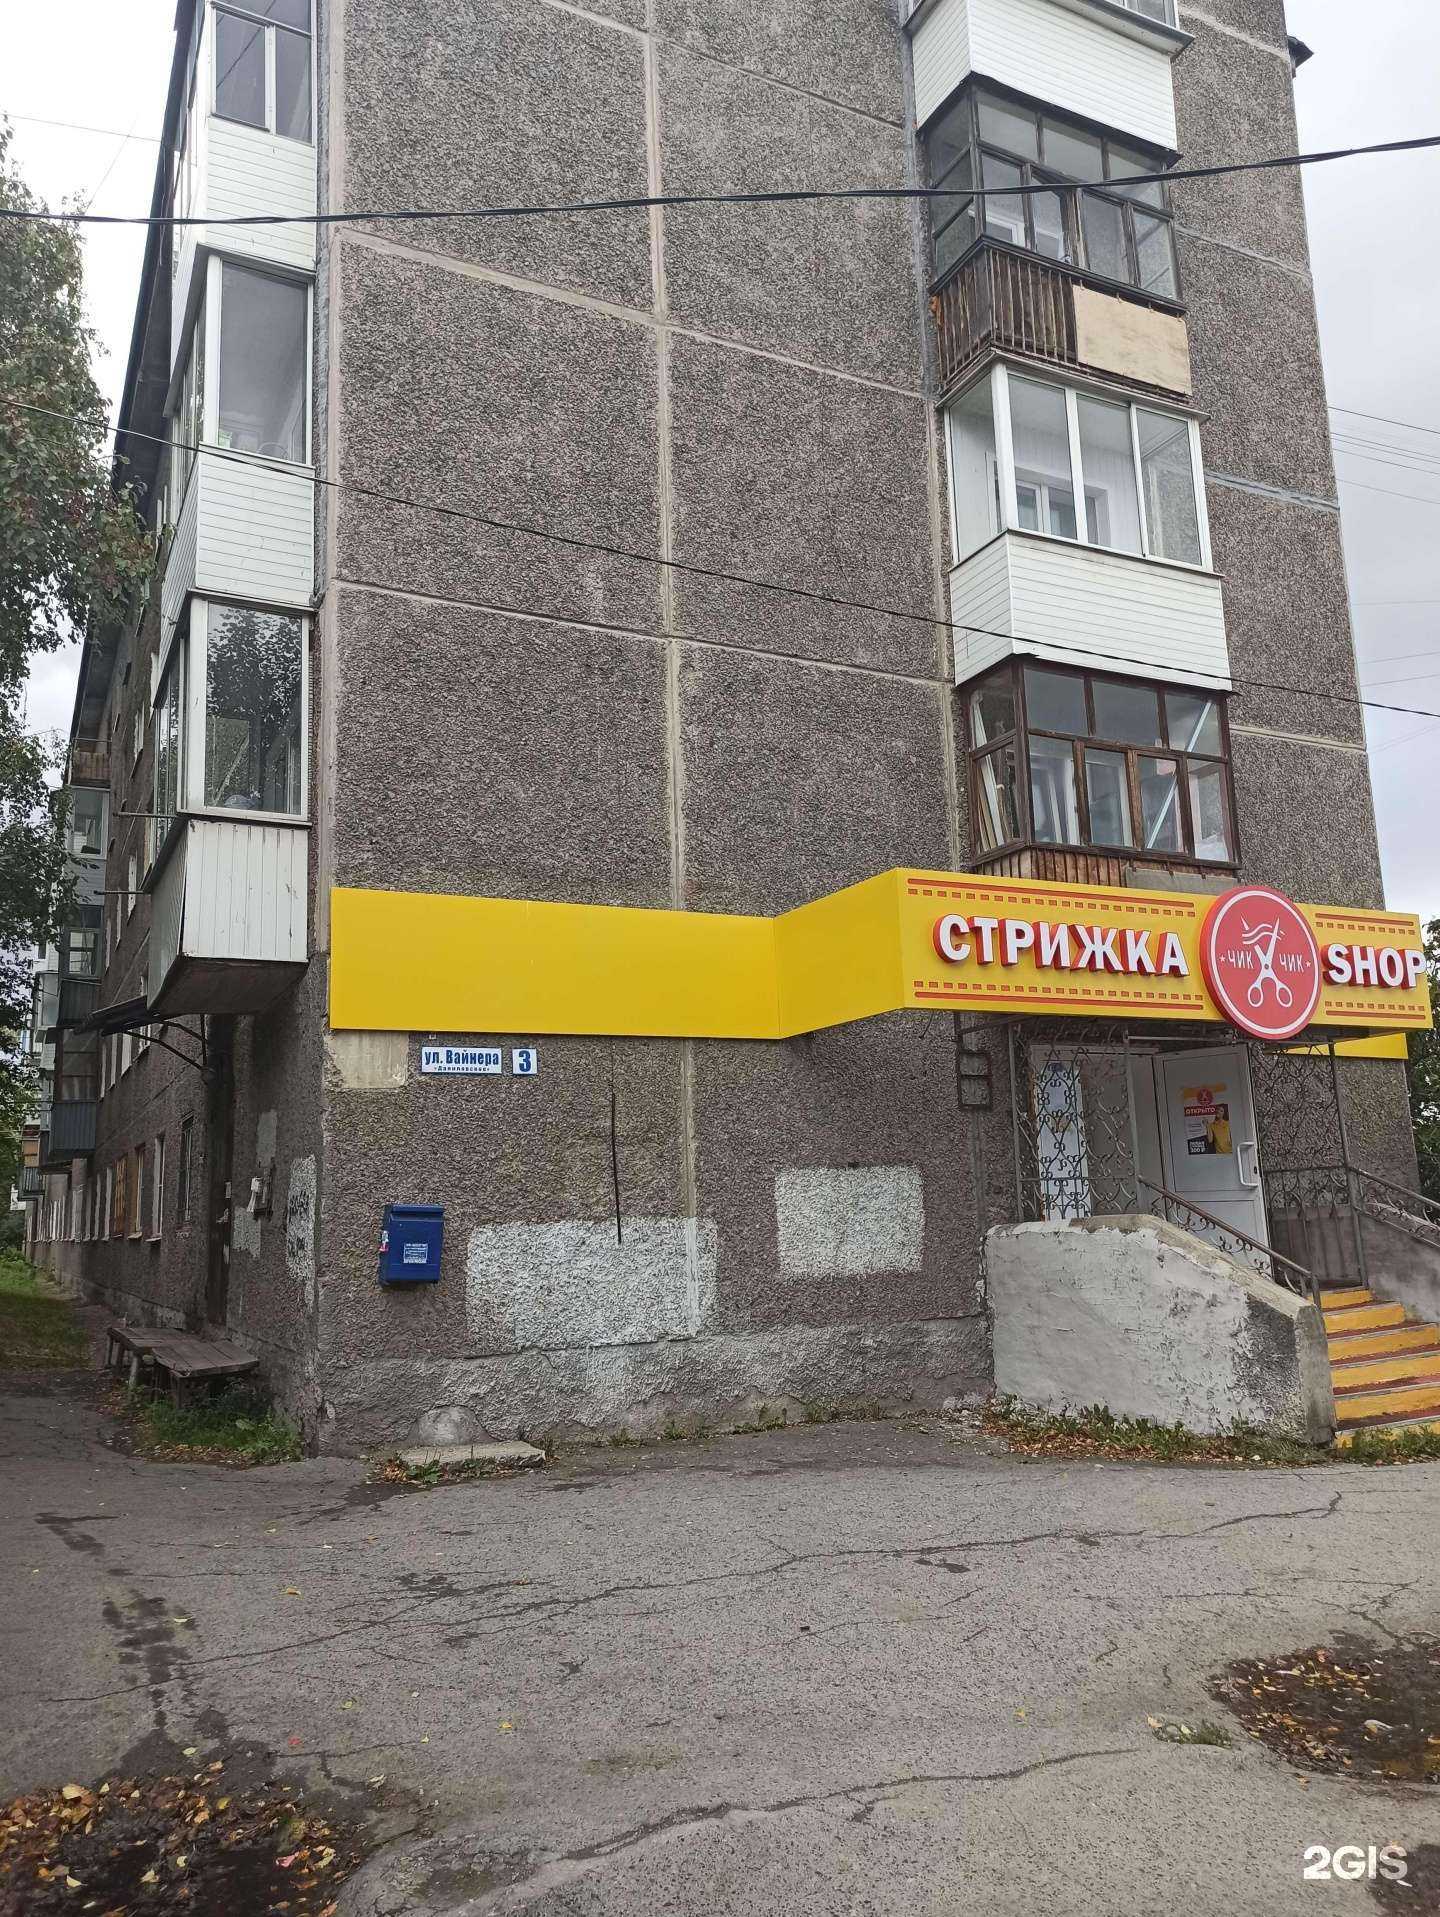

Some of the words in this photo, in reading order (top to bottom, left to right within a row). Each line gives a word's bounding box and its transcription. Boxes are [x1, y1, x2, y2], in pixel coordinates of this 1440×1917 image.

[935, 914, 1190, 976] СТРИЖКА
[1227, 950, 1254, 969] ЧИК
[1279, 953, 1304, 973] ЧИК
[1323, 943, 1427, 988] SHOP
[424, 1051, 444, 1066] ул.
[445, 1049, 499, 1066] Вайнера
[518, 1050, 532, 1073] 3
